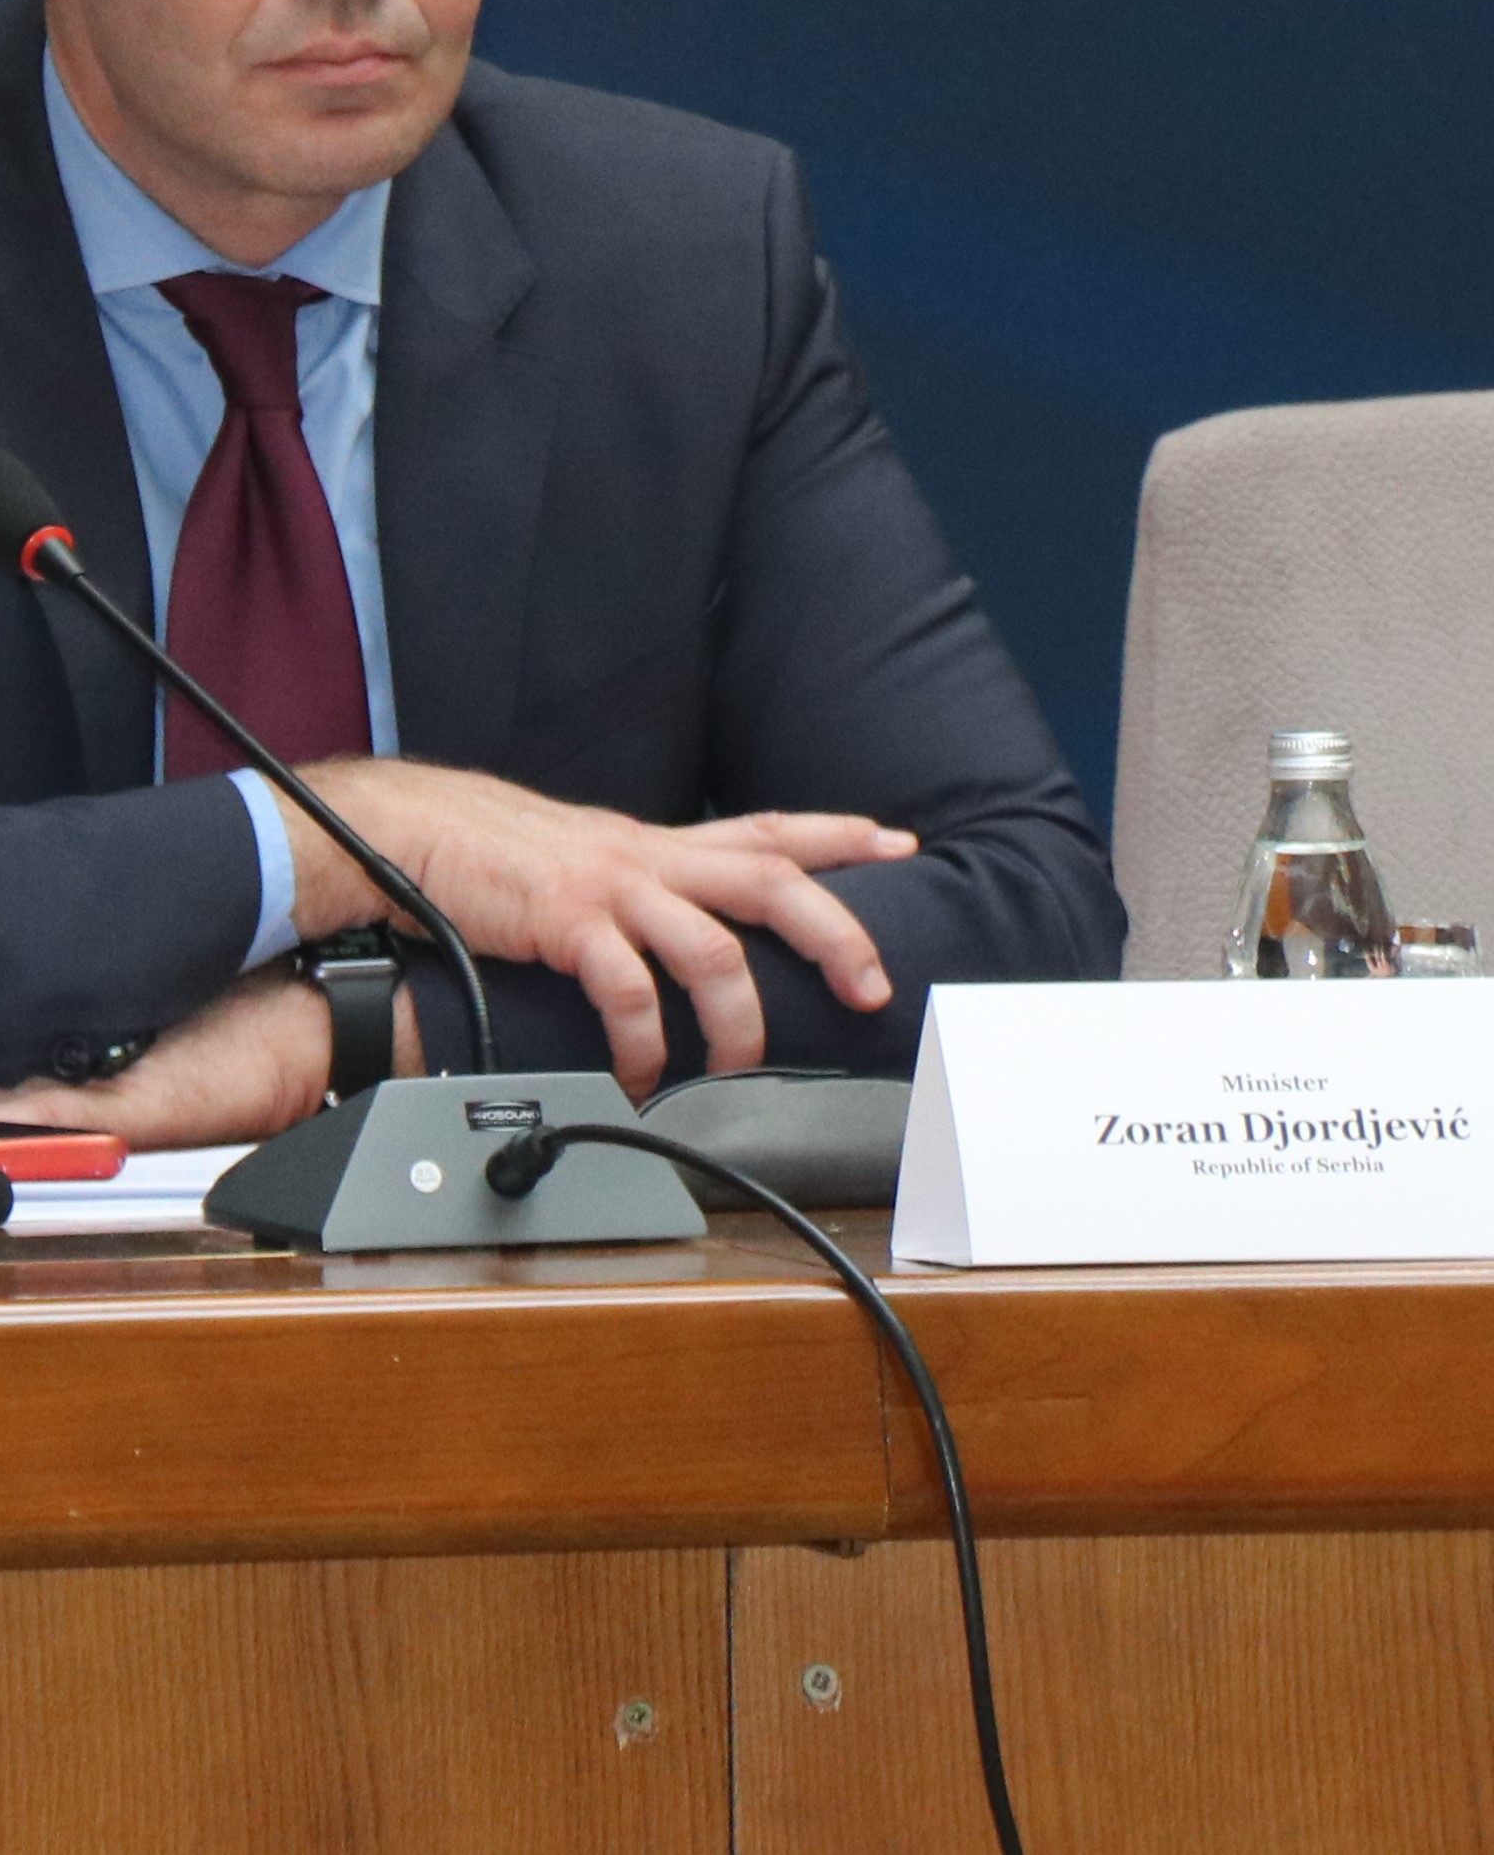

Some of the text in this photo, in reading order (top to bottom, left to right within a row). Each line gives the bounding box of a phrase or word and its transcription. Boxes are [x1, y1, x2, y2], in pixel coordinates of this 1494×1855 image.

[1221, 1073, 1329, 1092] Minister
[1093, 1107, 1471, 1151] Zoran Djordjević
[1192, 1156, 1385, 1180] Republic of Serbia
